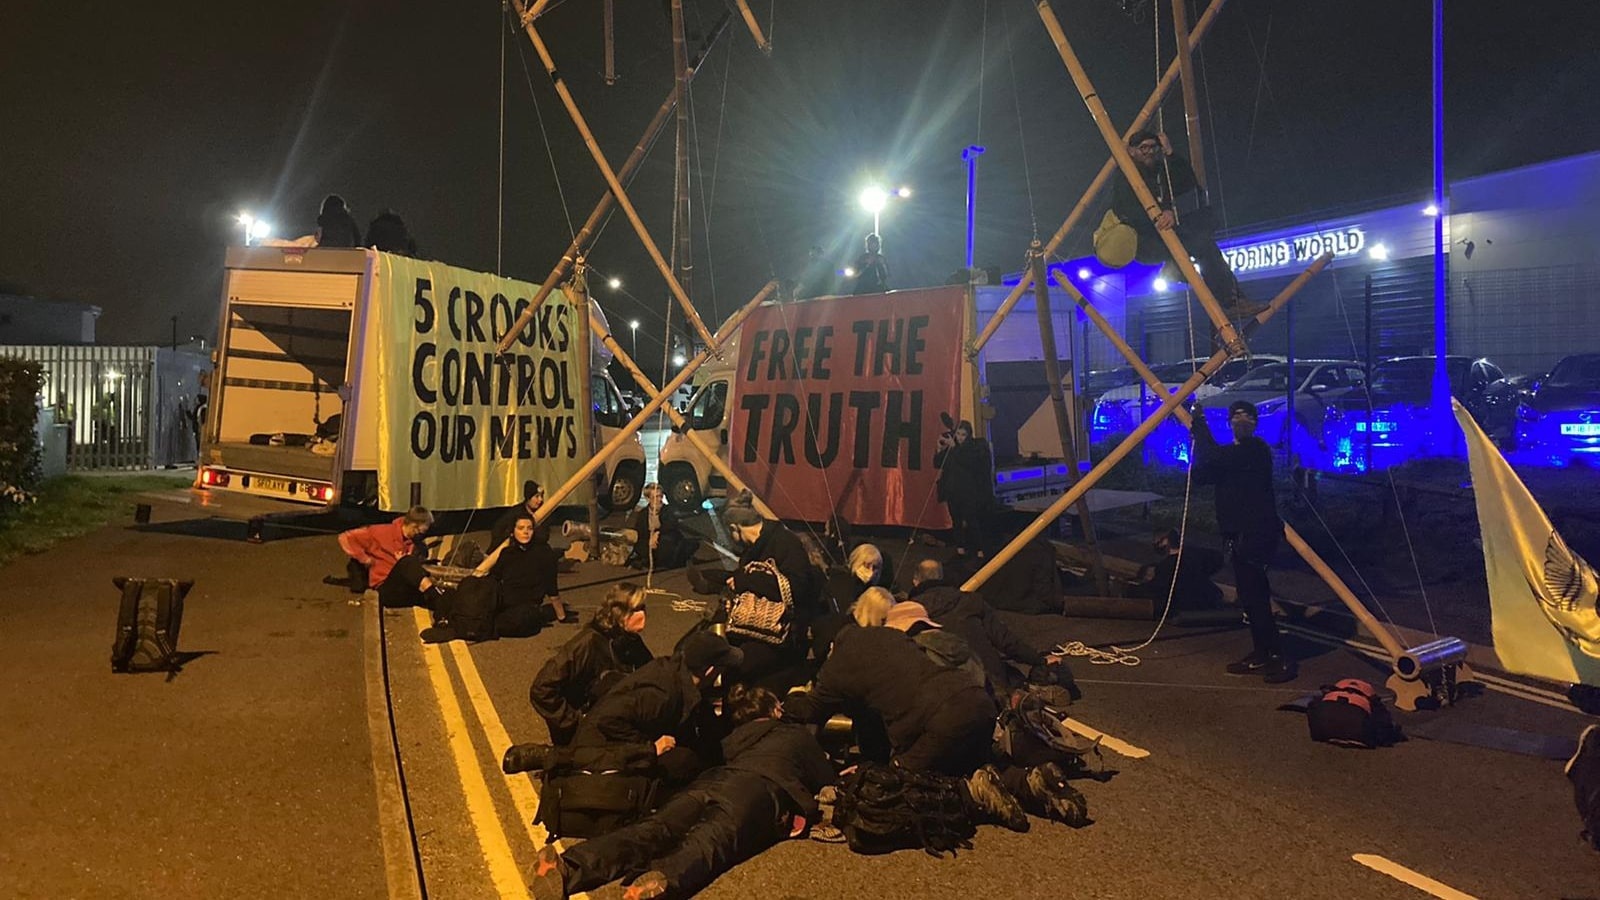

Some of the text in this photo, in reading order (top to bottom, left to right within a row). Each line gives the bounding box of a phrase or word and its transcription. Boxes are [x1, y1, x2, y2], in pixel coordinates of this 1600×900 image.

[1223, 230, 1362, 270] TORING WORLD
[414, 277, 570, 353] 5 CROOKS
[747, 315, 930, 382] FREE THE
[412, 342, 575, 409] CONTROL
[411, 410, 577, 463] OUR NEWS
[741, 389, 923, 471] TRUTH
